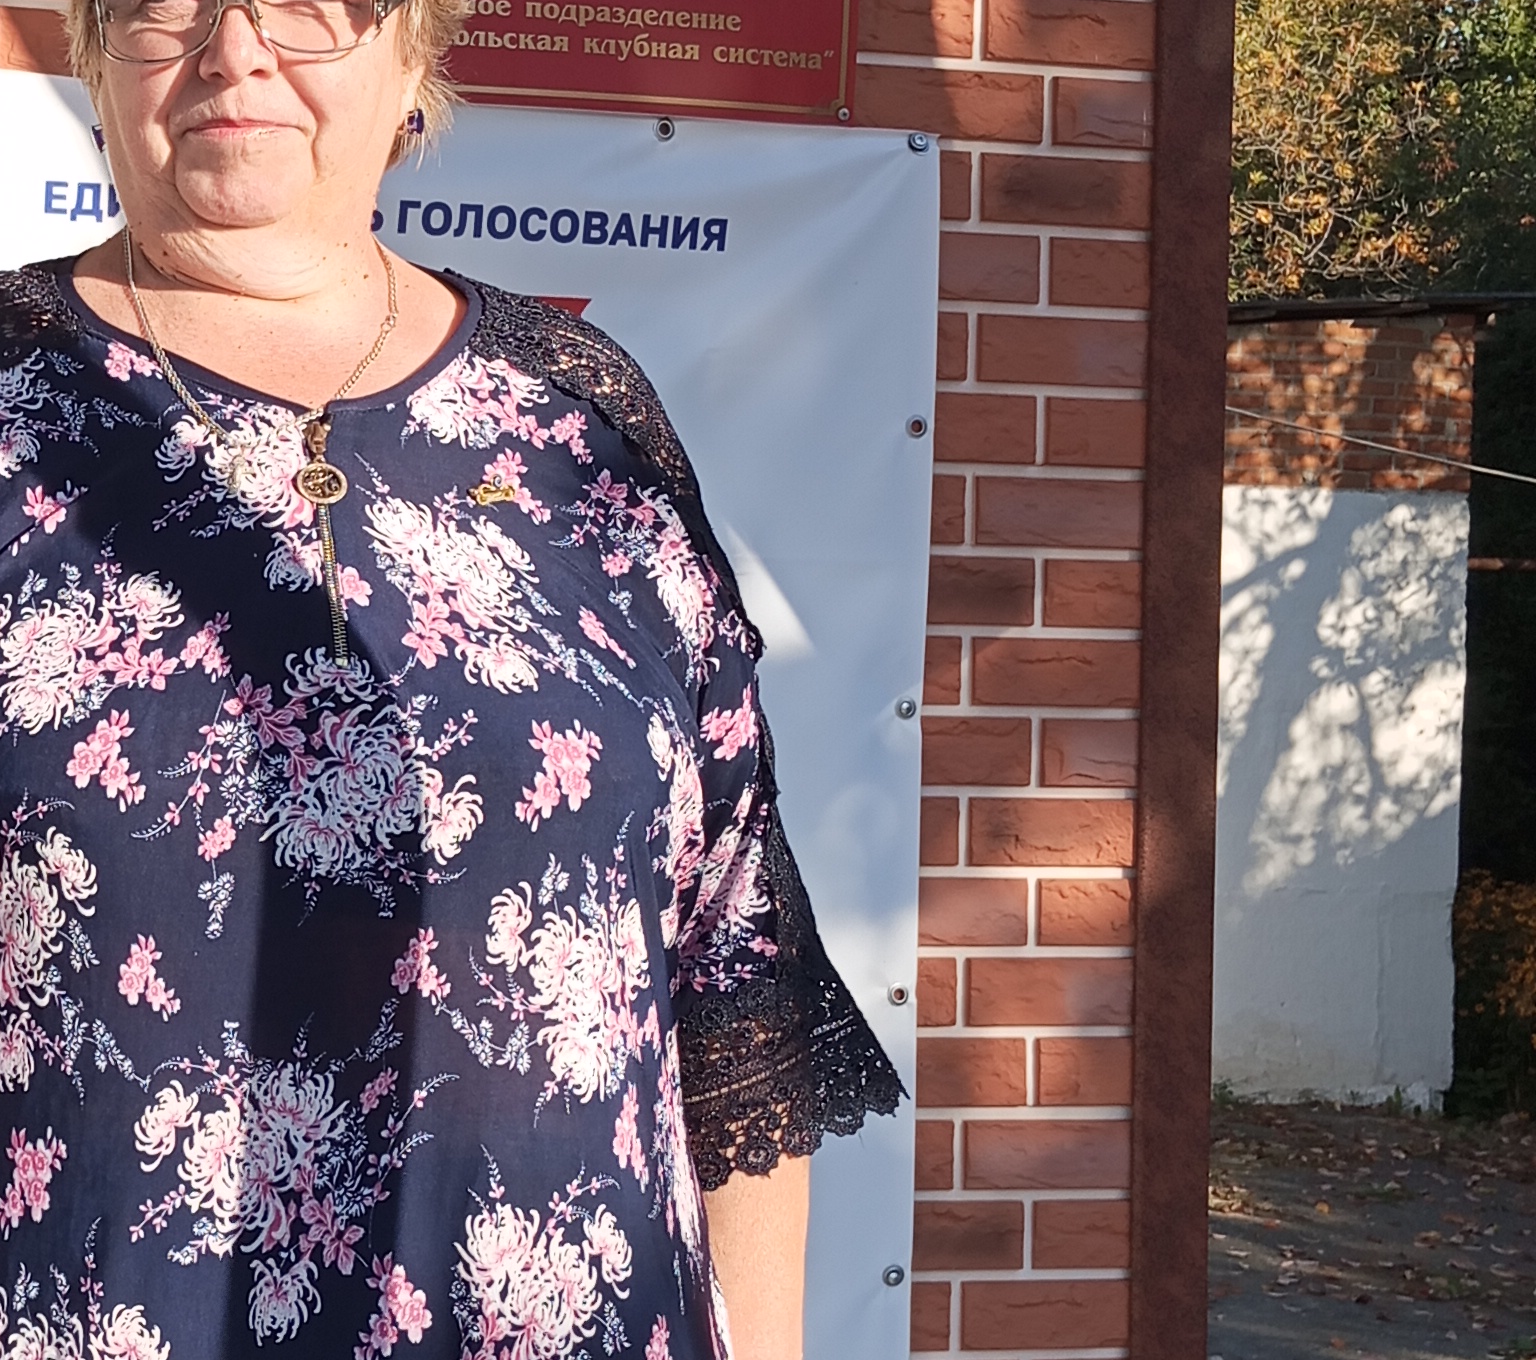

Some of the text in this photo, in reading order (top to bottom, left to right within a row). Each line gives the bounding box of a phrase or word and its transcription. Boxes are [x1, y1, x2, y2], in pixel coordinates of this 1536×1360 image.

[525, 0, 742, 34] подразделение
[449, 28, 569, 53] ольская
[583, 30, 700, 64] клубная
[397, 199, 729, 254] ГОЛОСОВАНИЯ
